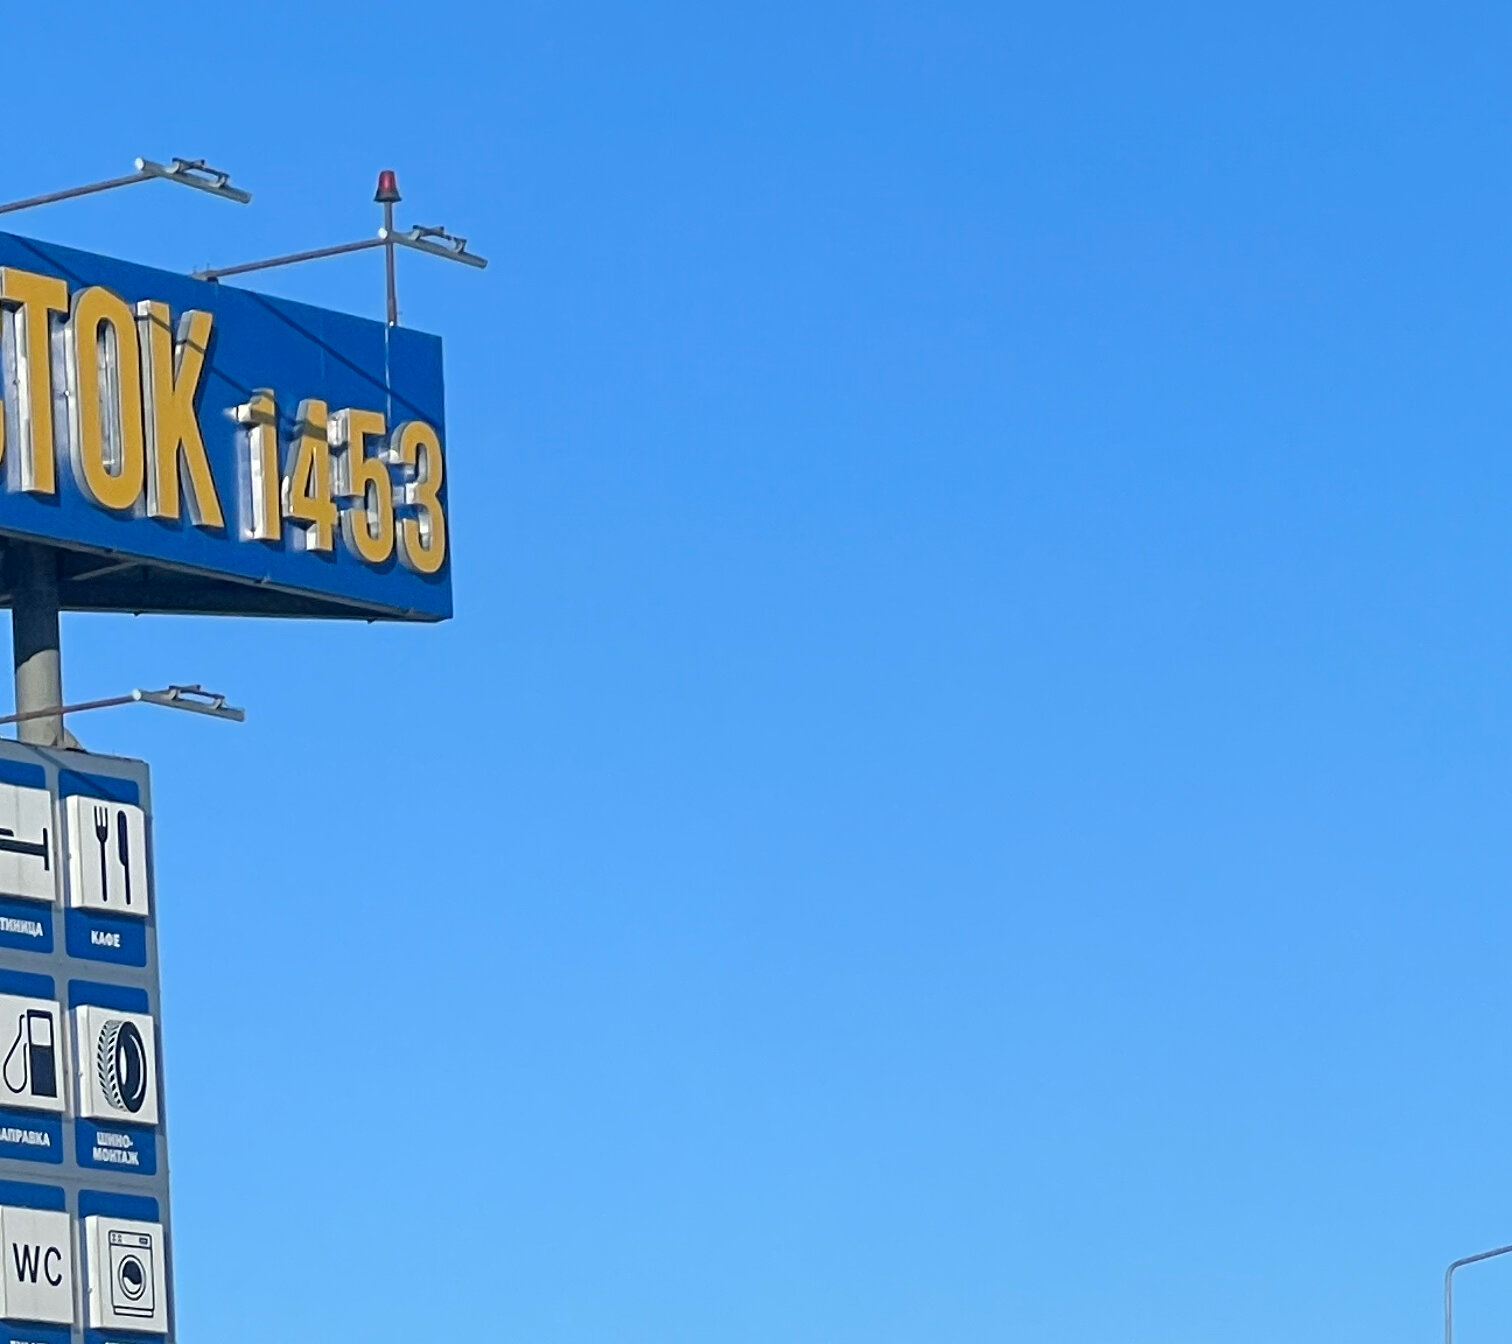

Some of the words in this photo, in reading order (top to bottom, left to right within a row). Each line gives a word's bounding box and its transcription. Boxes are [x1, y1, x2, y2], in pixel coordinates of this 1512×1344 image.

[234, 387, 445, 576] 1453
[90, 930, 121, 948] КАФЕ
[96, 1131, 134, 1149] ШИНО-
[92, 1146, 140, 1166] МОНТАЖ
[12, 1242, 63, 1287] WC
